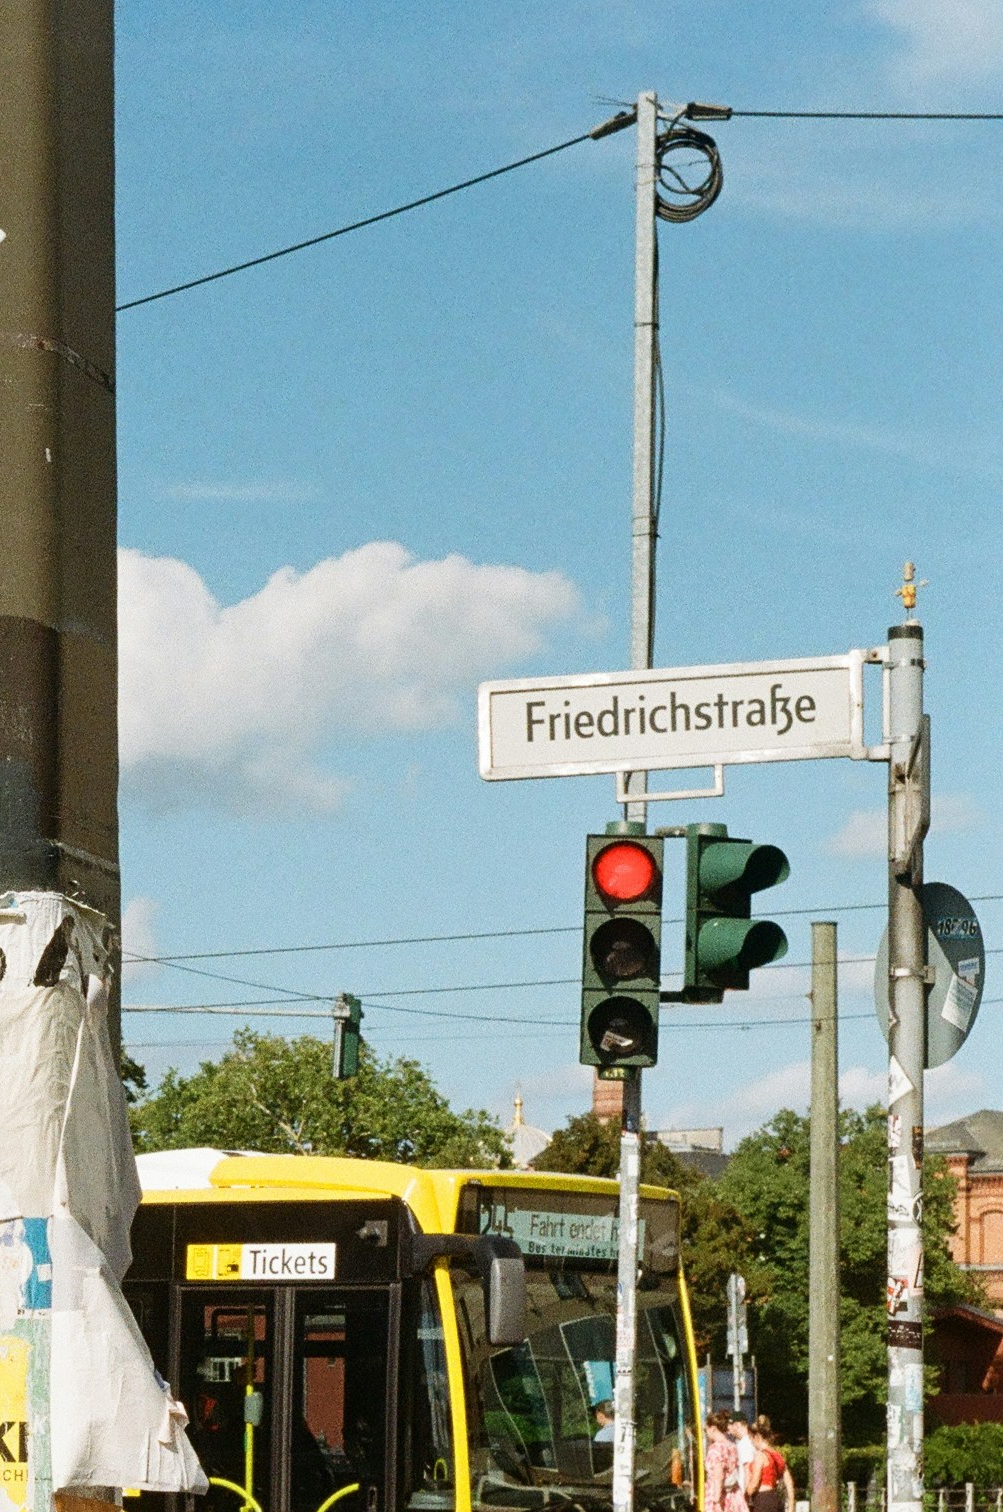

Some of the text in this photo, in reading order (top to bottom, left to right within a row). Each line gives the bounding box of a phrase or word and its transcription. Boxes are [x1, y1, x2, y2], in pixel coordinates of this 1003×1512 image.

[525, 683, 817, 743] Friedrichstraße
[529, 1214, 565, 1237] Fahrt
[250, 1249, 329, 1277] Tickets
